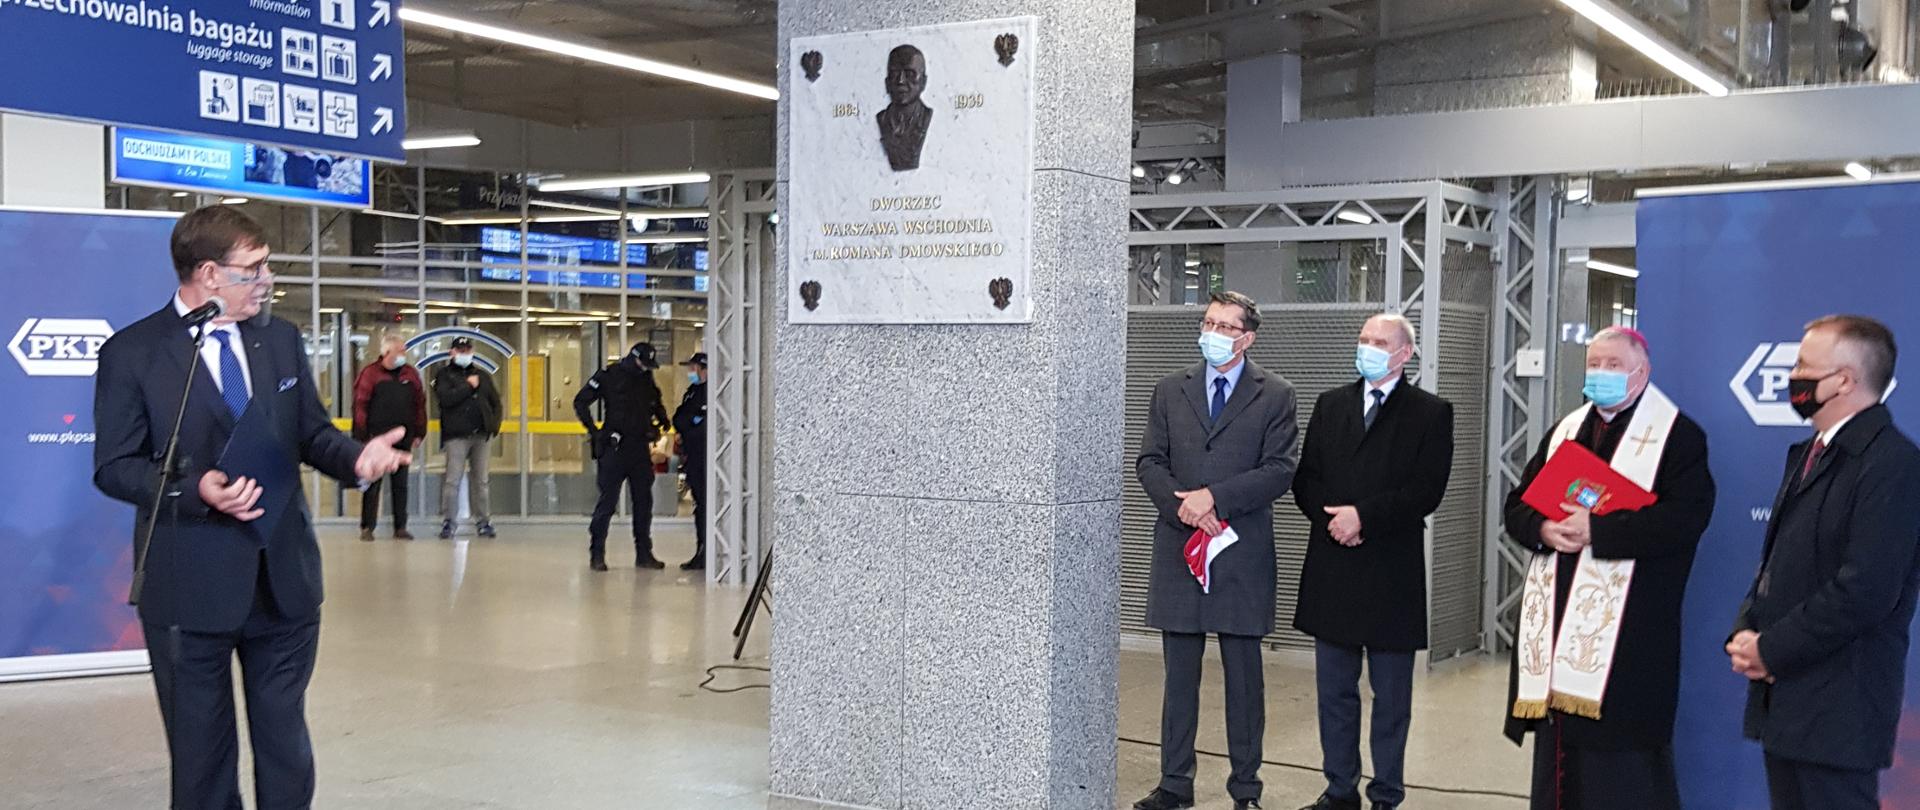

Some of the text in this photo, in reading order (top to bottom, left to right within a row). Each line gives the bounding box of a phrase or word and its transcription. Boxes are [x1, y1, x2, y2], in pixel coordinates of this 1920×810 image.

[189, 9, 273, 49] bagażu
[186, 40, 273, 70] luggage storage
[870, 195, 942, 212] DWORZEC
[820, 217, 993, 237] WARSZAWA WSCHODNIA
[830, 244, 893, 261] ROMANA
[899, 240, 1005, 259] DMOWSKIEGO
[27, 335, 102, 359] PKP
